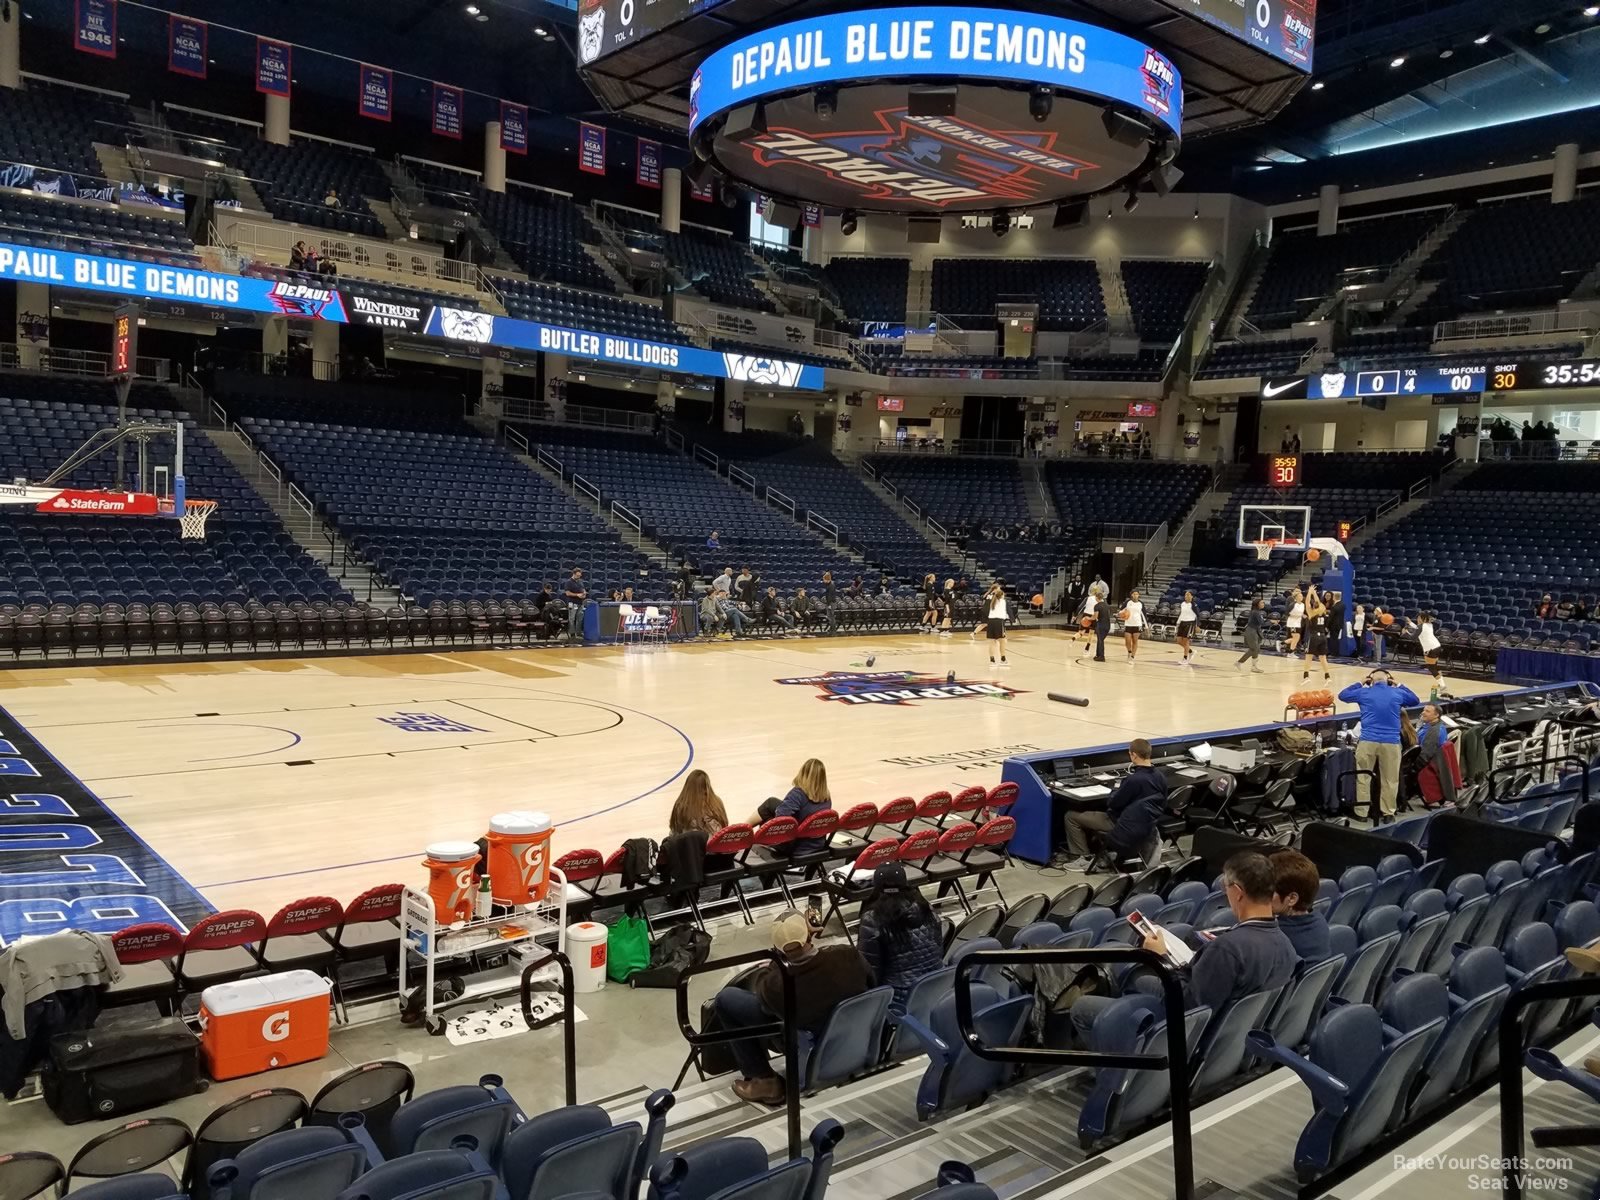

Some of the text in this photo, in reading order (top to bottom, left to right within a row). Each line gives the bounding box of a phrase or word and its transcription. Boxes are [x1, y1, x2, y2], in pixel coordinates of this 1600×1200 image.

[620, 0, 634, 26] 0
[1256, 0, 1270, 28] 0
[88, 15, 104, 26] NIT
[80, 29, 112, 45] 1945
[175, 37, 200, 49] NCAA
[614, 29, 634, 44] TOL 4
[1251, 28, 1270, 45] TOL 4
[731, 20, 1086, 90] DEPAUL BLUE DEMONS
[262, 58, 286, 71] NCAA
[366, 84, 387, 95] NCAA
[438, 103, 457, 112] NCAA
[505, 120, 522, 130] NCAA
[584, 141, 600, 151] NCAA
[1009, 149, 1075, 170] BLUE
[757, 133, 988, 201] DEPAUL
[453, 220, 465, 228] 226
[0, 248, 239, 303] PAUL BLUE DEMONS
[170, 306, 185, 316] 123
[353, 296, 420, 319] WINTRUST
[210, 311, 225, 320] 124
[366, 315, 407, 328] ARENA
[540, 327, 679, 367] BUTLER BULLDOGS
[1439, 366, 1486, 375] TEAM FOULS
[1494, 365, 1517, 373] SHOT
[1372, 375, 1384, 391] 0
[1404, 377, 1415, 392] 4
[1451, 375, 1471, 390] 00
[1494, 373, 1515, 389] 30
[1275, 457, 1297, 467] 35:53
[1277, 467, 1294, 483] 30
[564, 857, 600, 867] STAPLES
[286, 905, 332, 919] STAPLES
[205, 919, 255, 933] STAPLES
[117, 933, 170, 947] STAPLES
[262, 1011, 289, 1042] G
